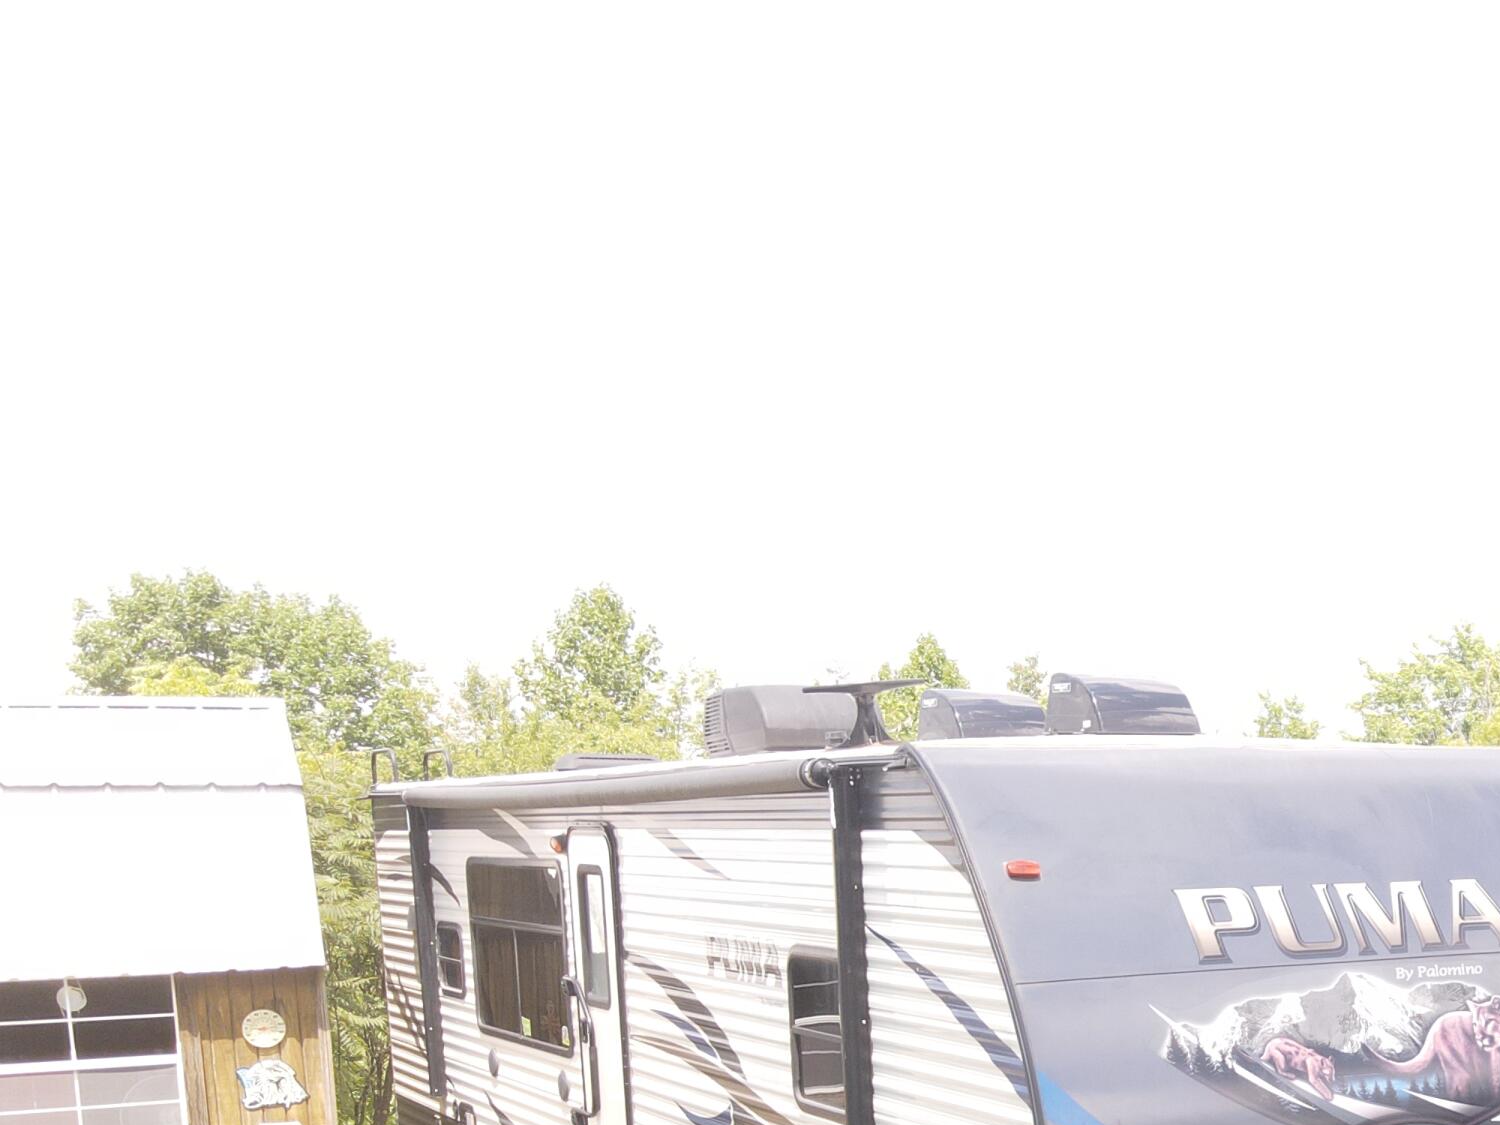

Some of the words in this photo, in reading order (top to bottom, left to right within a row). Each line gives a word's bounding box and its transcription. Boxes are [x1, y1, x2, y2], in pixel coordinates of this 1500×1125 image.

[704, 935, 783, 988] PUMA
[1395, 967, 1414, 981] By
[1417, 963, 1483, 978] Palomino
